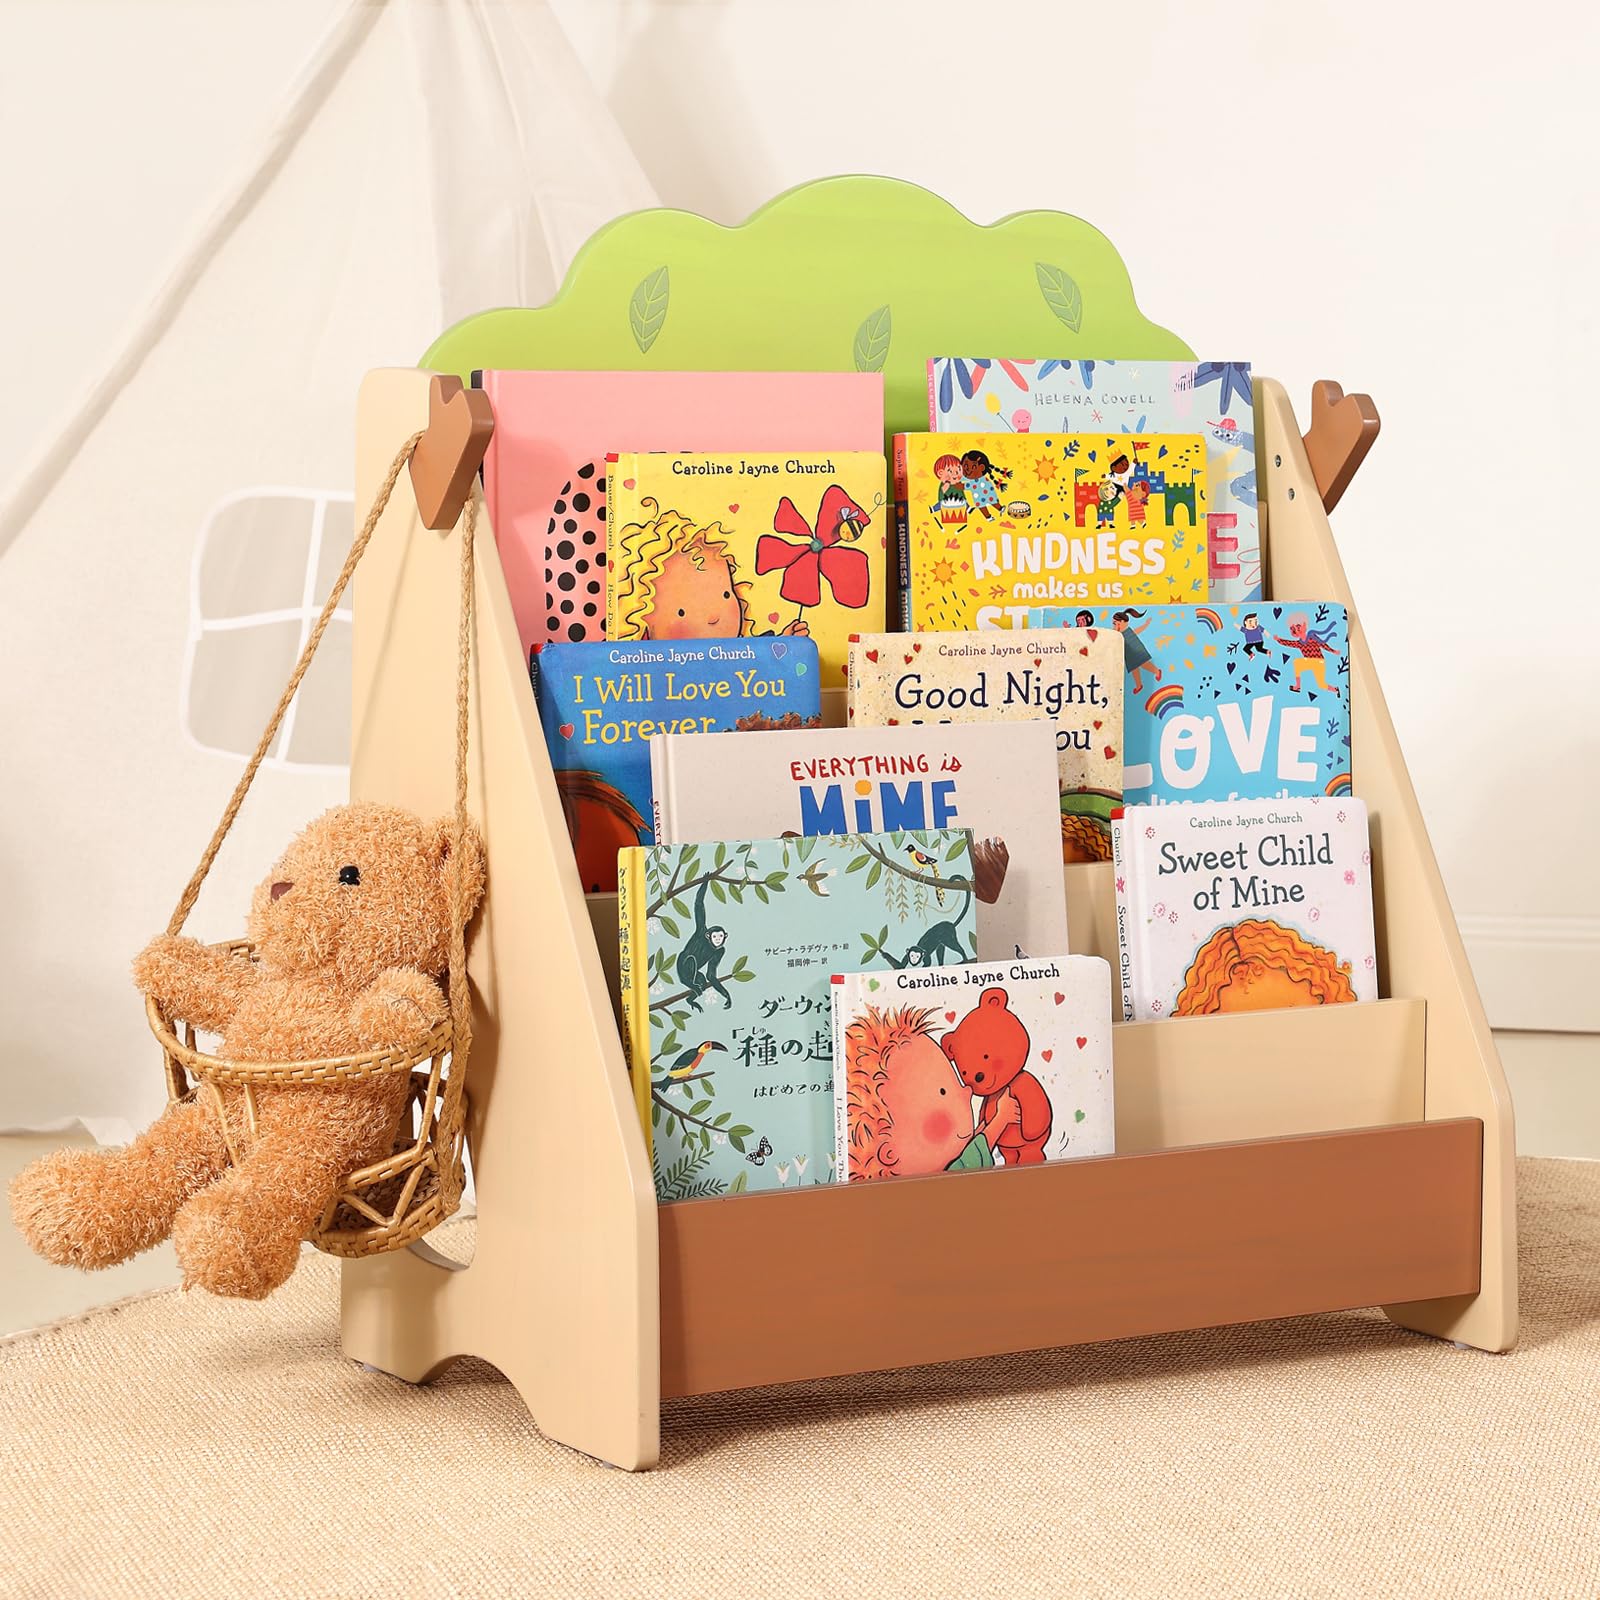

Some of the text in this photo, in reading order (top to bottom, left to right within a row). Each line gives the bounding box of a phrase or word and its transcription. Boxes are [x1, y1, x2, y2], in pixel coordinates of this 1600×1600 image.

[1034, 393, 1156, 406] HELENA COVELL
[672, 459, 836, 479] Caroline Jayne Church
[898, 523, 908, 586] KINDNESS
[971, 532, 1166, 580] KINDNESS
[1012, 576, 1124, 599] makes us
[608, 612, 614, 628] Do
[609, 646, 756, 665] Caroline Jayne Church
[938, 642, 1067, 658] Caroline Jayne Church
[573, 670, 786, 704] I Will Love You
[895, 668, 1109, 715] Good Night,
[581, 709, 716, 745] Forever
[790, 753, 962, 781] EVERYTHING is
[1189, 812, 1303, 829] Caroline Jayne Church
[1113, 827, 1121, 867] Church
[1158, 833, 1333, 875] Sweet Child
[1193, 876, 1305, 911] of Mine
[1117, 905, 1128, 948] Sweet
[897, 963, 1060, 990] Caroline Jayne Church
[1121, 952, 1131, 989] Child
[1123, 994, 1133, 1010] of
